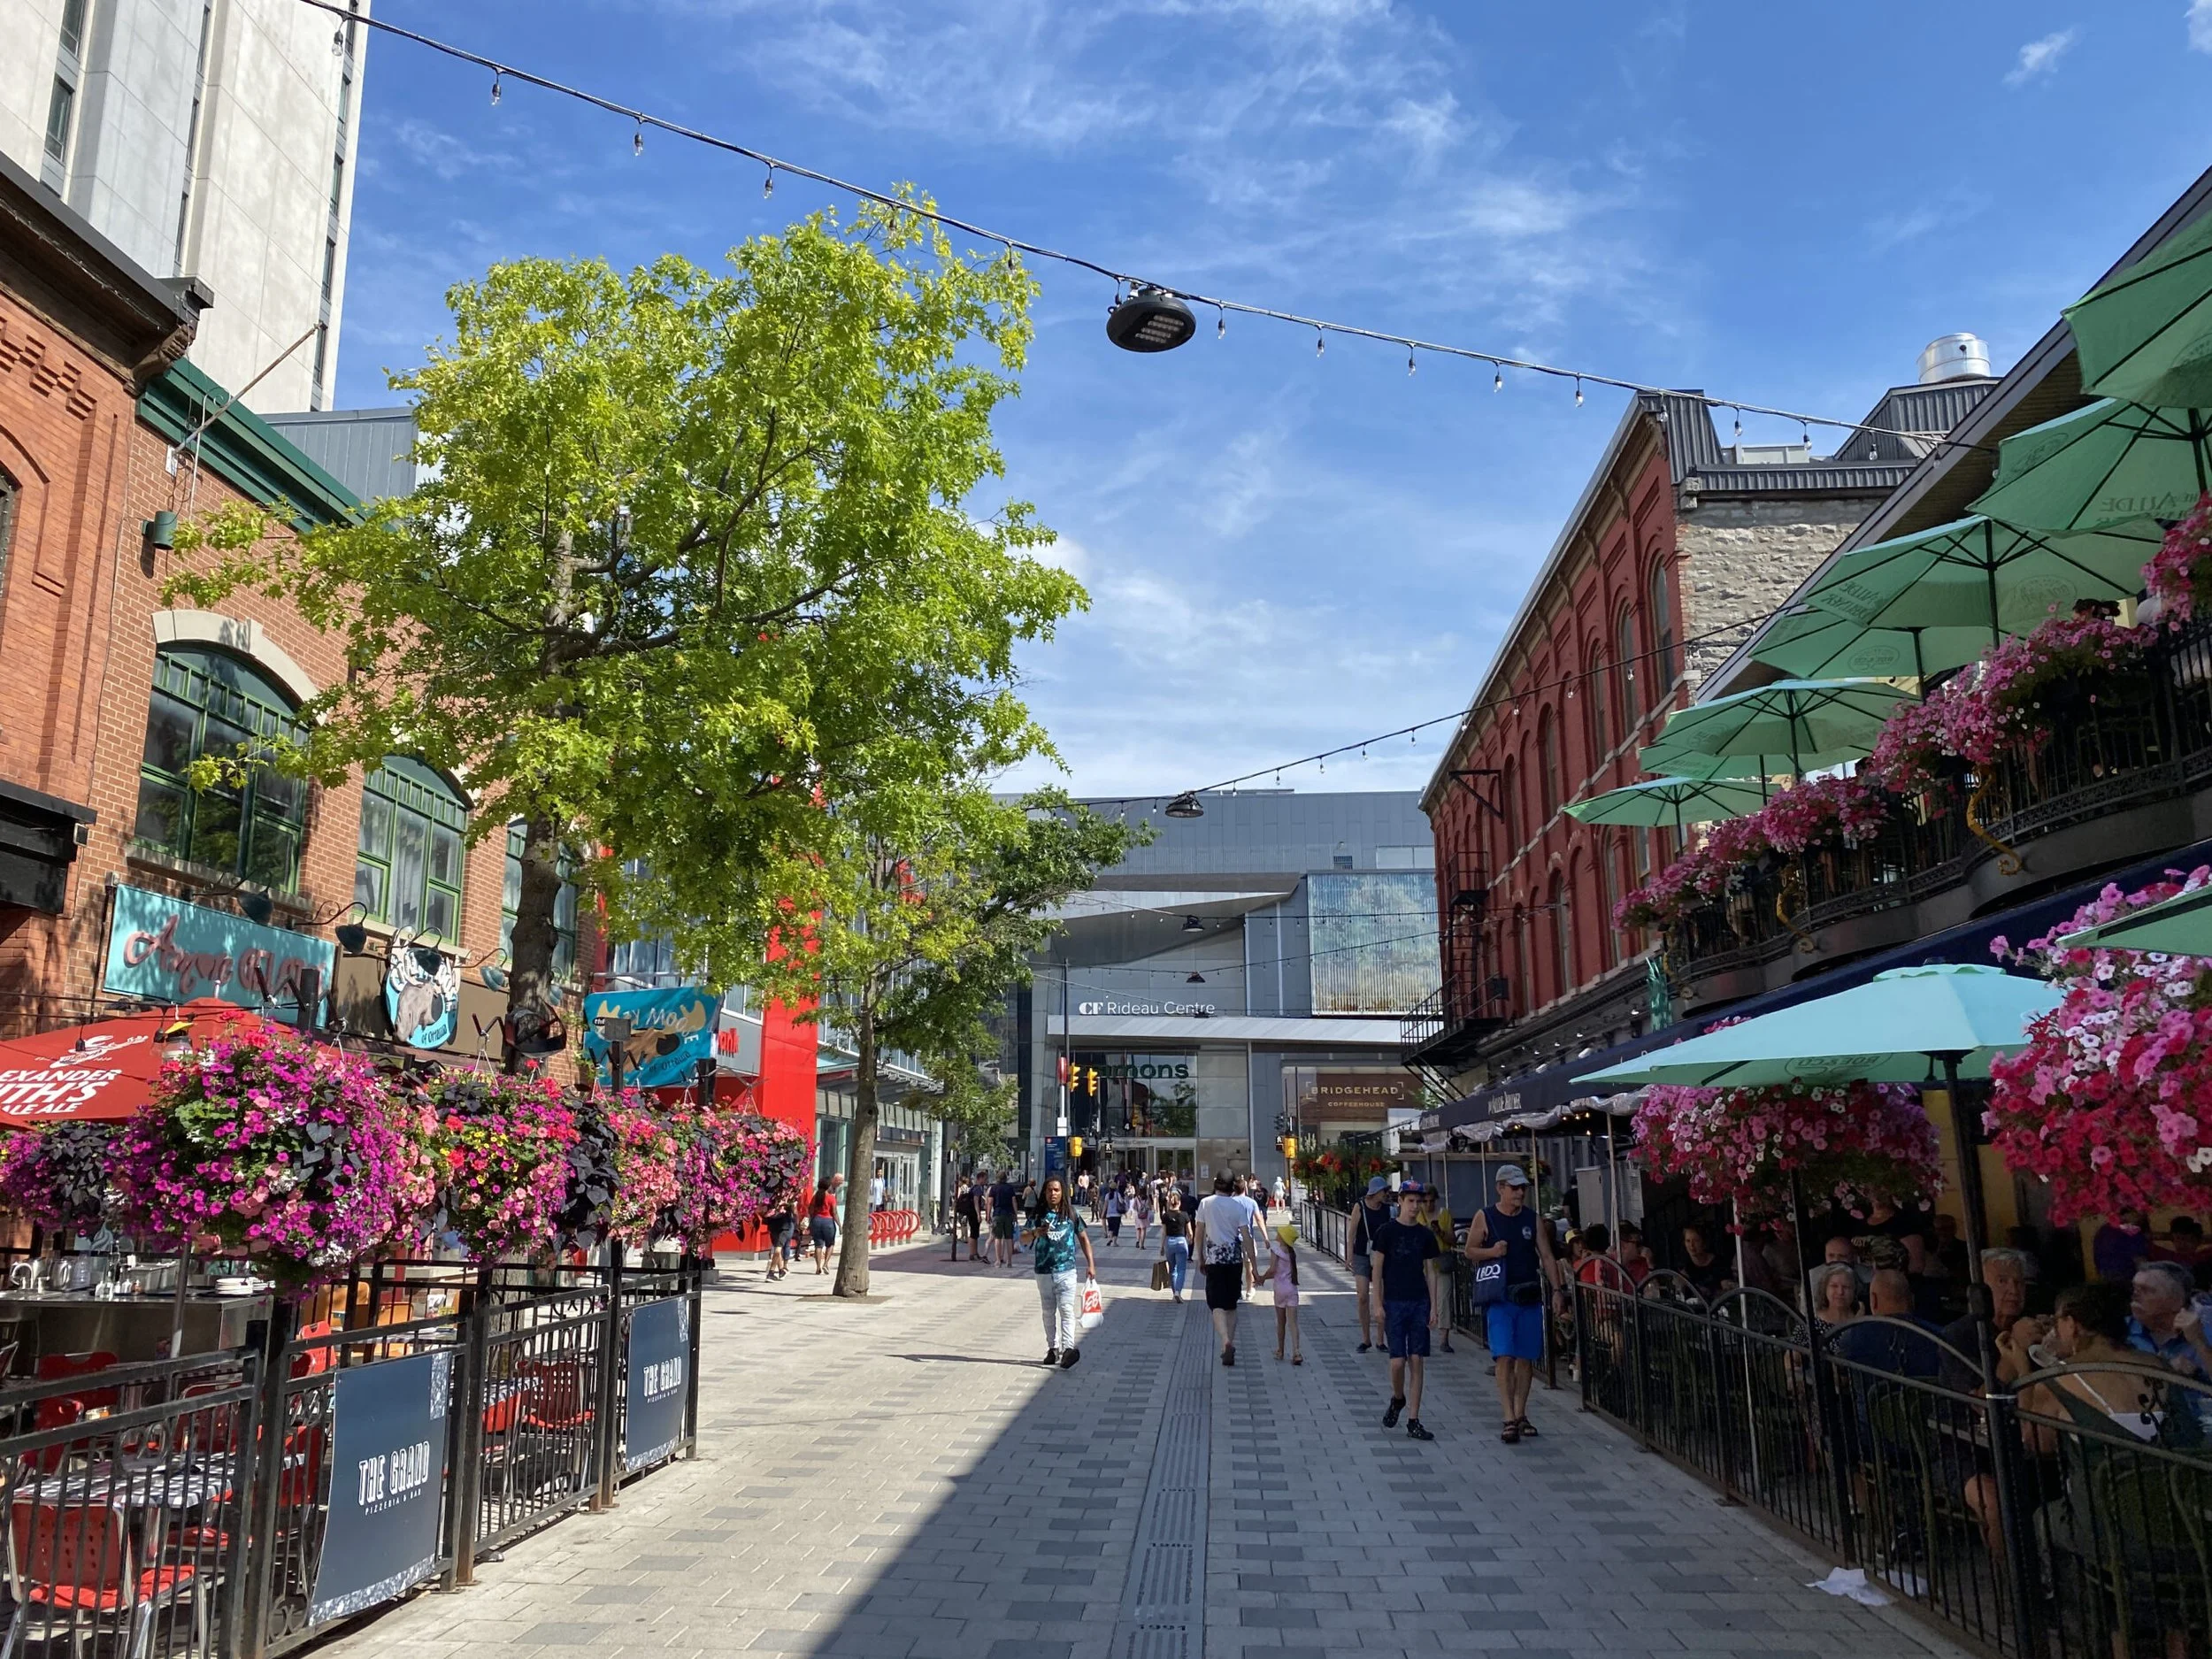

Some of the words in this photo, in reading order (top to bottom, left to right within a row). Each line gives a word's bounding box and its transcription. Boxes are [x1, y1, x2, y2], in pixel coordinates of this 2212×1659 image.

[1079, 1002, 1103, 1015] CF
[1107, 1002, 1159, 1014] Rideau
[1164, 1002, 1216, 1014] Centre
[35, 1102, 83, 1114] ALE
[643, 1363, 658, 1397] THE
[660, 1356, 681, 1391] GRAND
[358, 1455, 386, 1506] THE
[389, 1440, 430, 1495] GRAND
[365, 1497, 400, 1516] PIZZERIA
[410, 1488, 421, 1499] BAR
